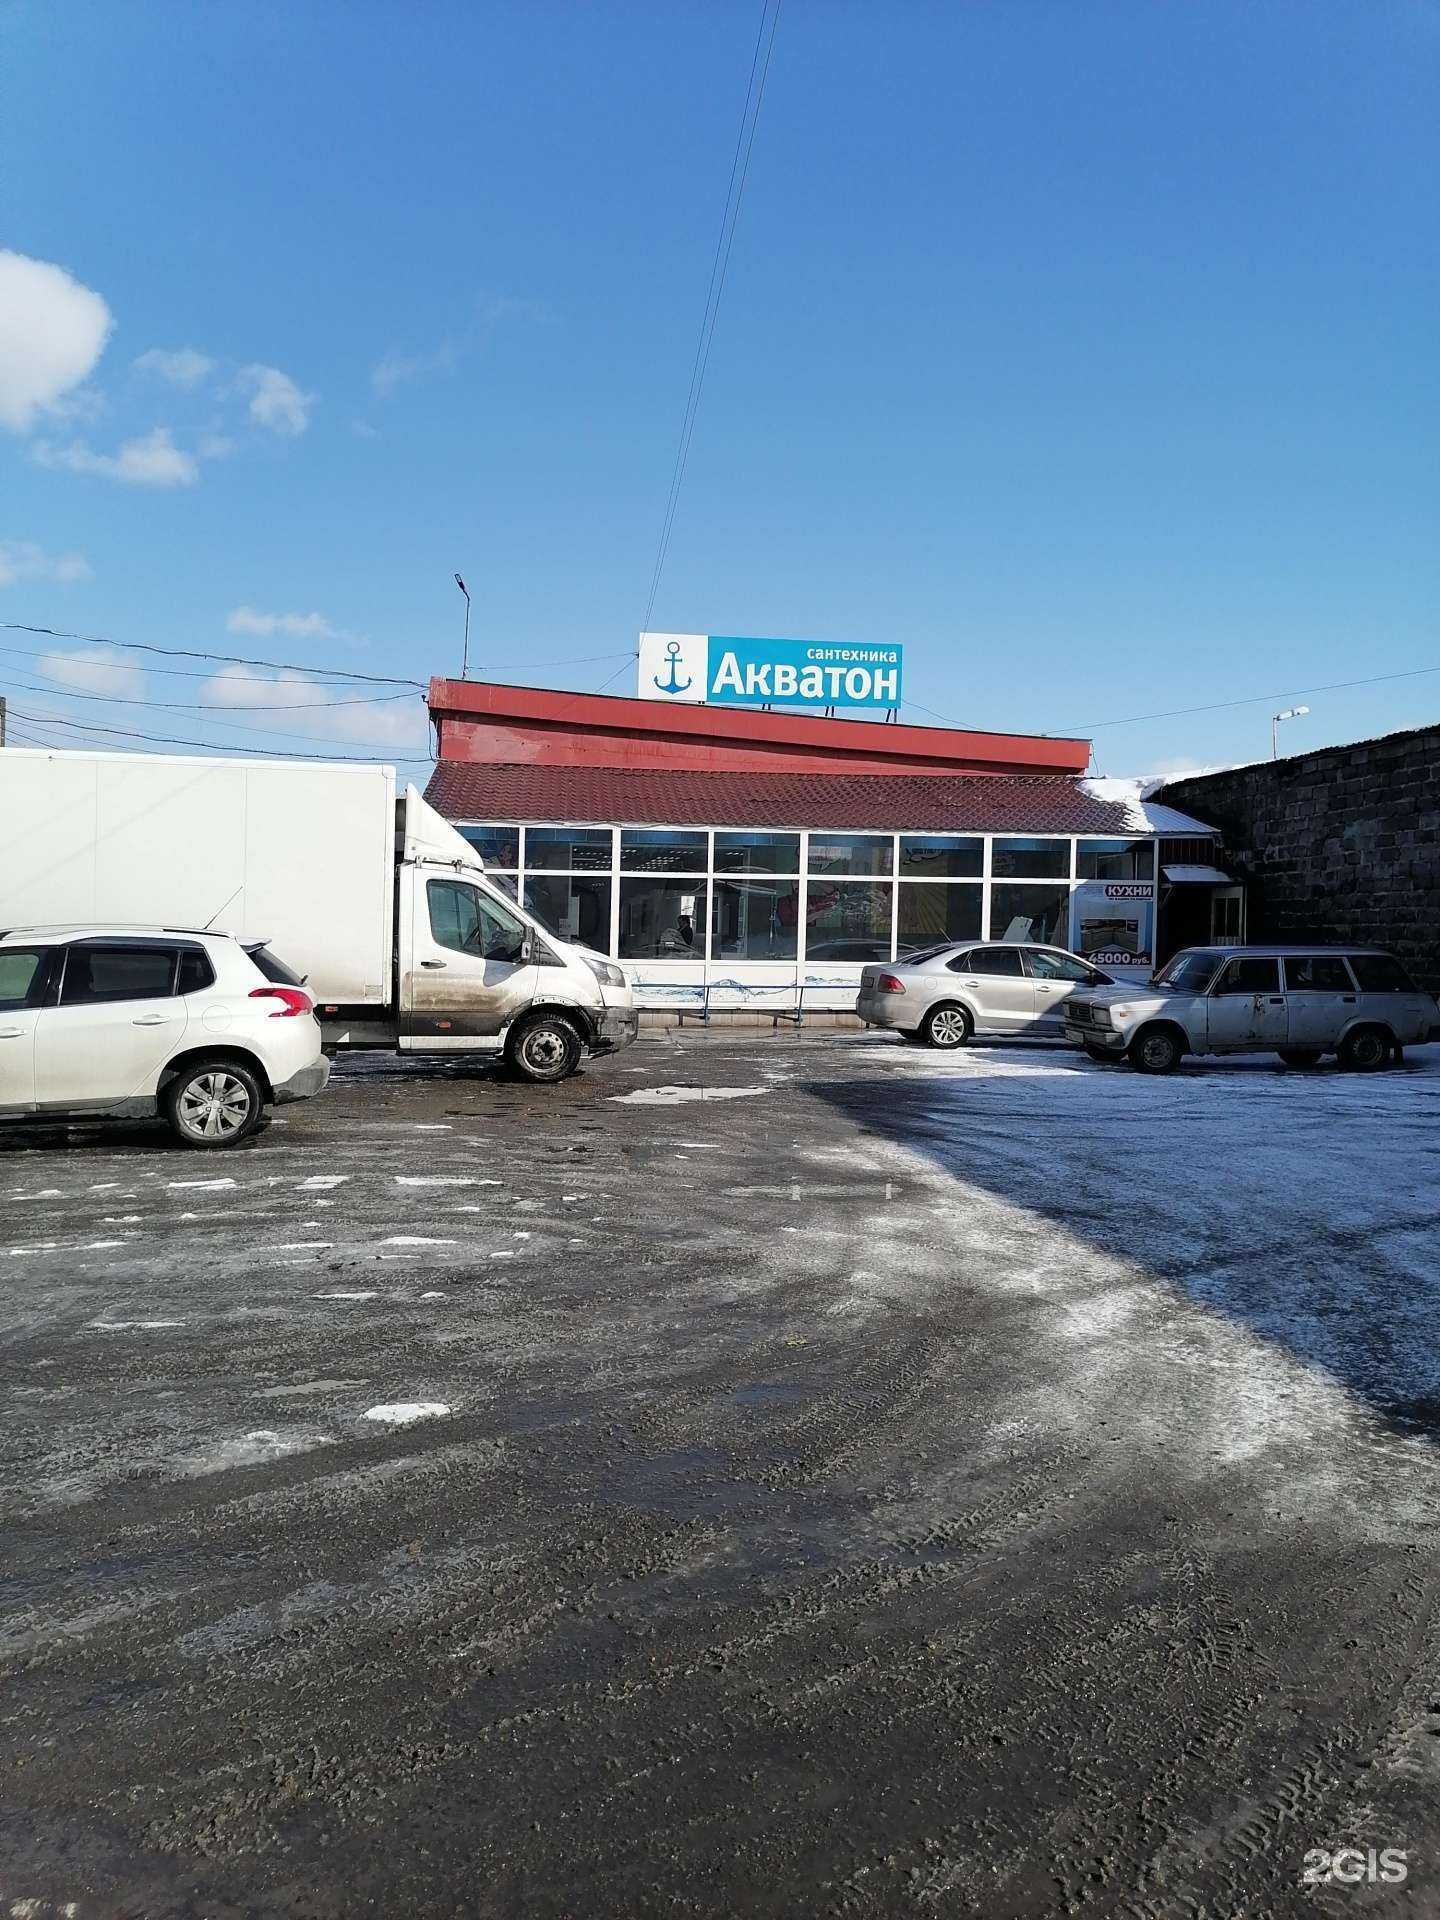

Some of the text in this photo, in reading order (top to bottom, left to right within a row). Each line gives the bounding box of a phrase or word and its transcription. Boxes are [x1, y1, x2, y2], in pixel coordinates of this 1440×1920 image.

[806, 646, 898, 663] сантехника
[711, 651, 898, 700] Акватон
[1108, 886, 1152, 896] КУХНИ
[1088, 953, 1150, 965] 45000 руб.
